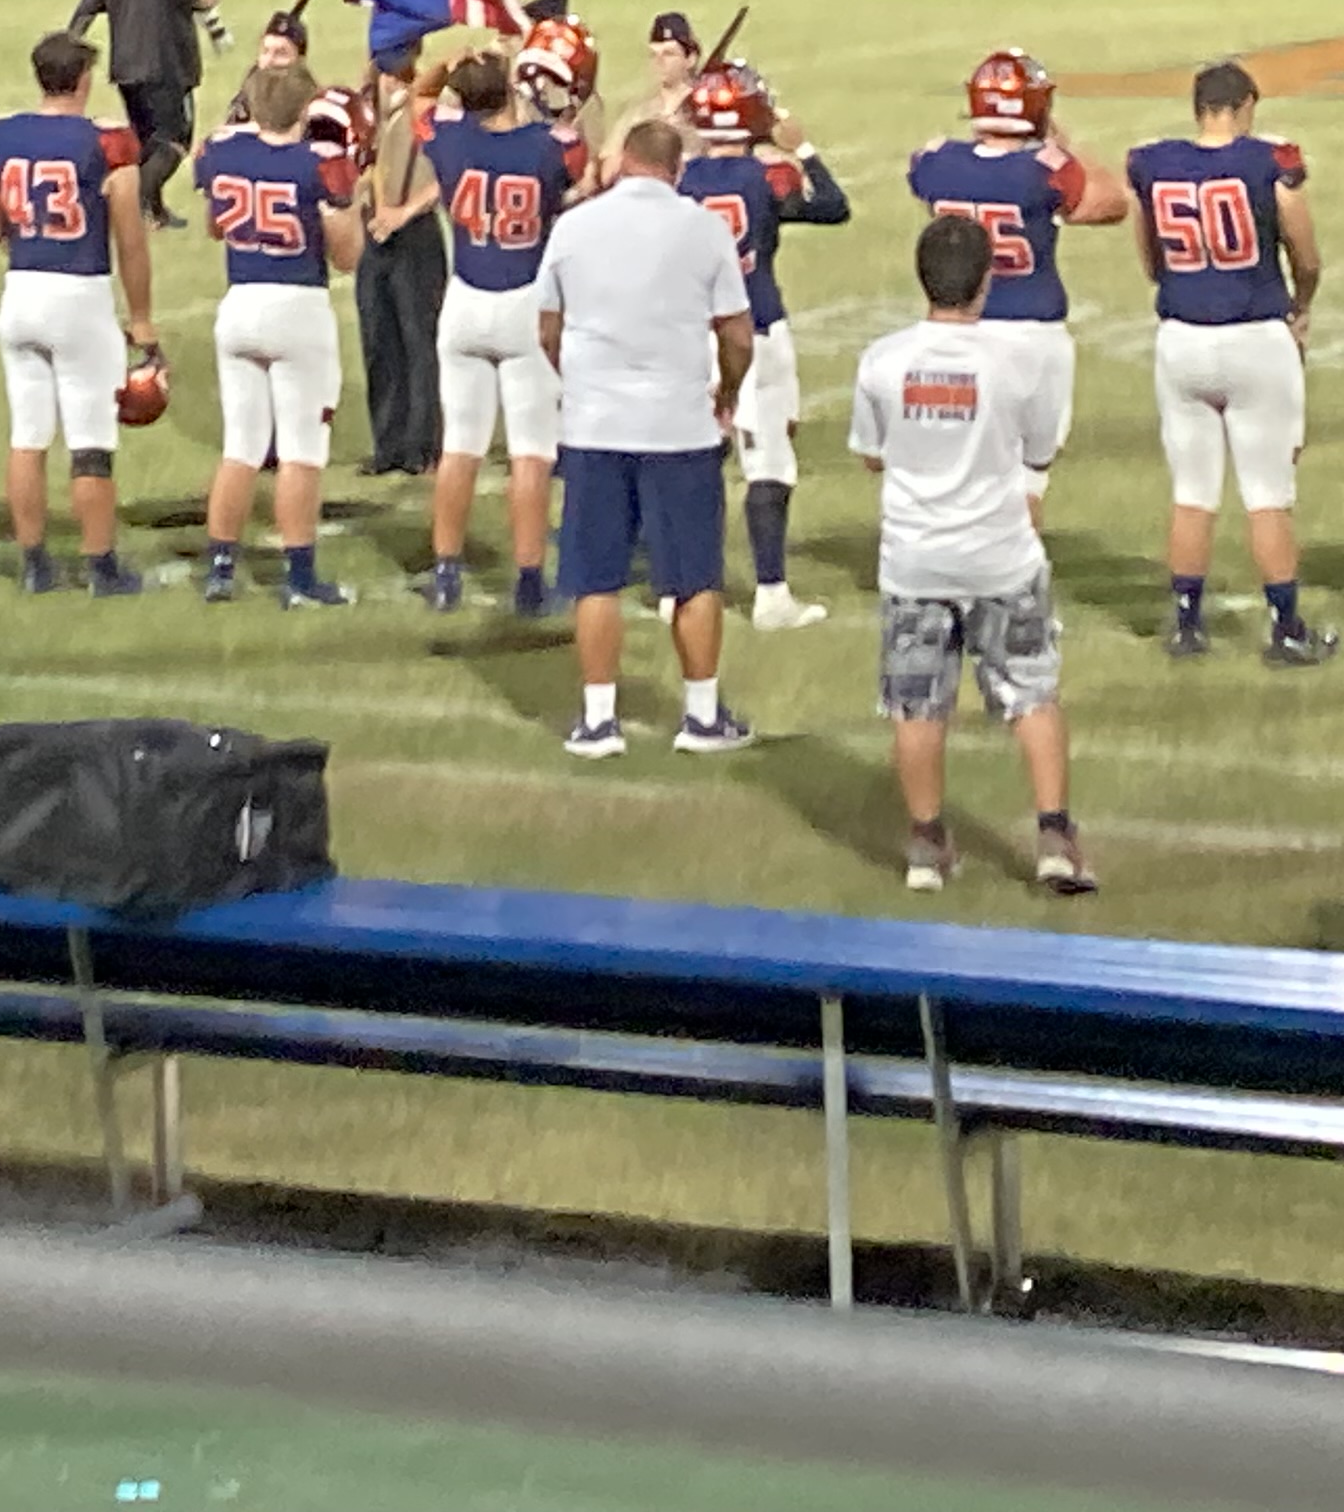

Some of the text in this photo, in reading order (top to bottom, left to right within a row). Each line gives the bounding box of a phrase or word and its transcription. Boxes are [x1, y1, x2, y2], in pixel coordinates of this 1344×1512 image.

[212, 175, 306, 255] 25
[452, 169, 541, 249] 48
[933, 200, 1035, 277] 5
[1152, 178, 1259, 272] 50
